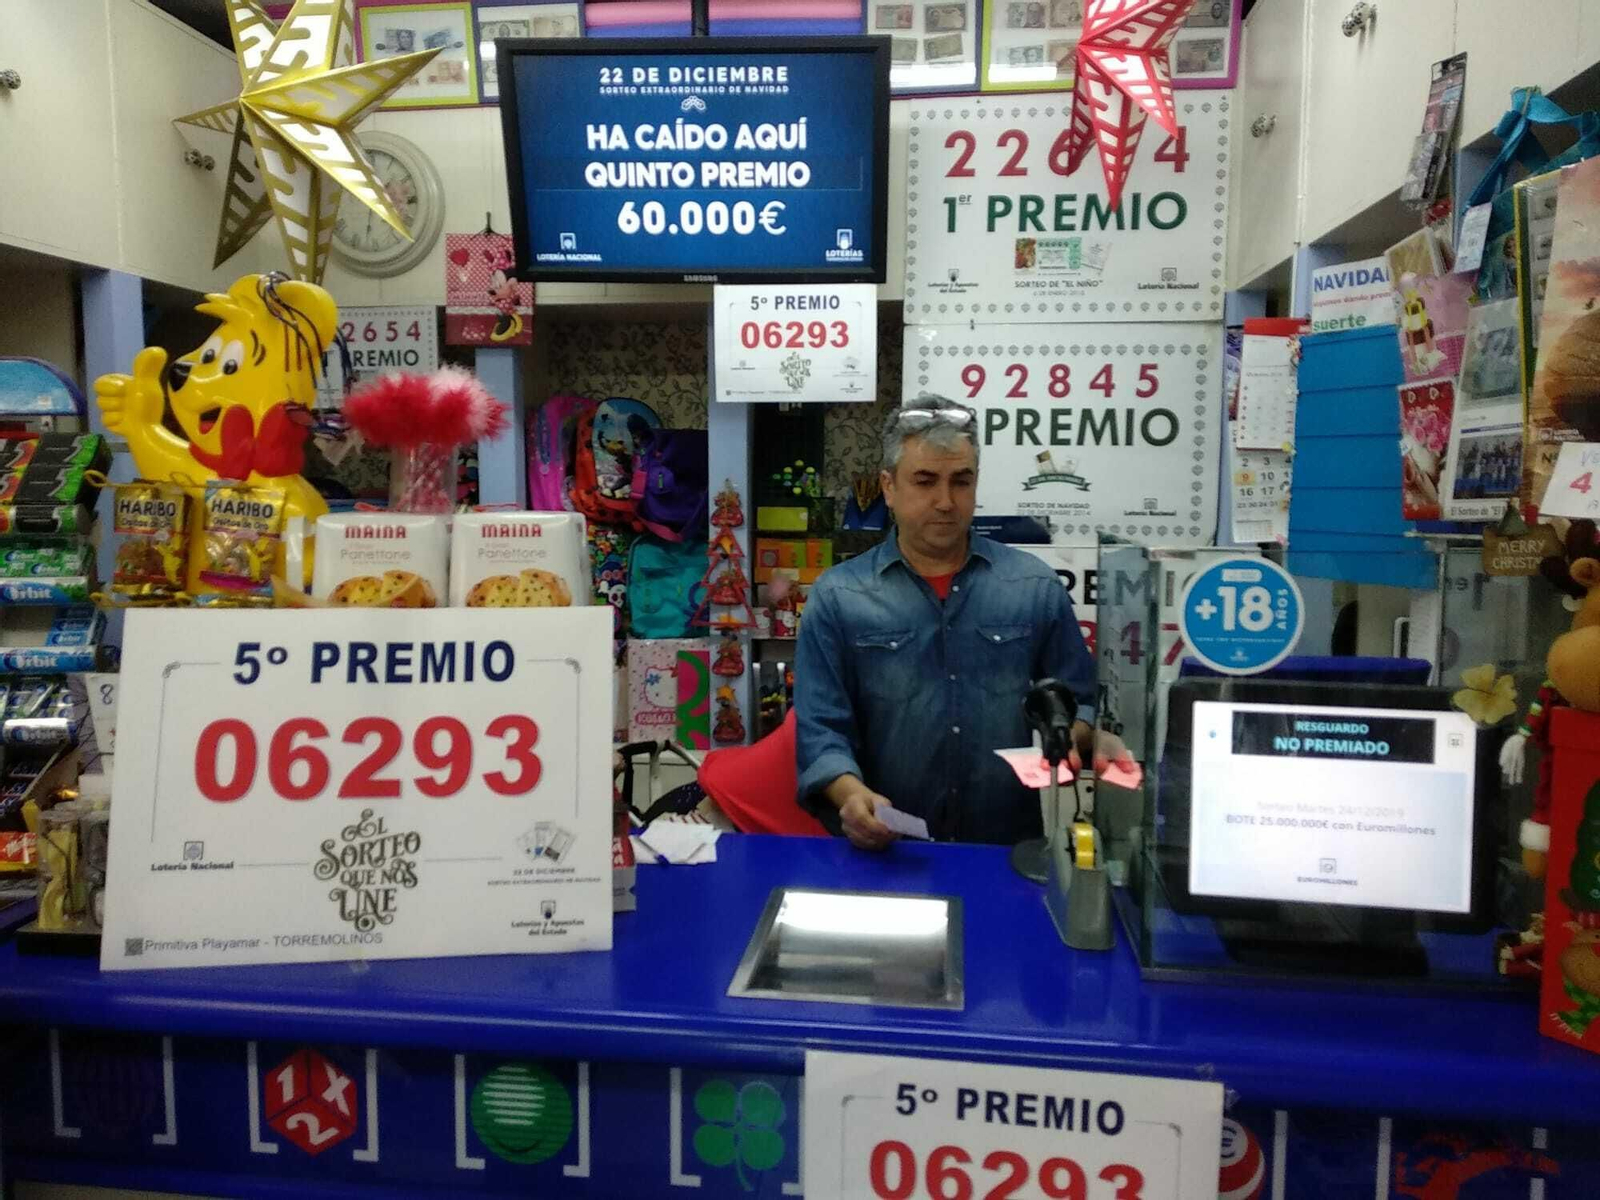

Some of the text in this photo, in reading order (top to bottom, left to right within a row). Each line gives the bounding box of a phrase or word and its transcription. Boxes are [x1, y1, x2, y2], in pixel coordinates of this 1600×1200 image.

[599, 66, 788, 83] 22 DE DICIEMBRE
[600, 86, 637, 94] SORTEO
[640, 86, 725, 94] EXTRAORDINARIO
[744, 85, 789, 93] NAVIDAD
[586, 117, 808, 150] HA CAÍDO AQUÍ
[584, 161, 811, 188] QUINTO PREMIO
[617, 200, 787, 236] 60.000€
[986, 191, 1188, 232] PREMIO
[774, 295, 840, 310] PREMIO
[1313, 314, 1366, 331] suerte
[741, 321, 849, 349] 06293
[961, 363, 1159, 398] 92845
[985, 408, 1180, 446] PREMIO
[1240, 487, 1254, 496] 16
[1569, 471, 1593, 494] 4
[119, 500, 176, 517] HARIBO
[211, 500, 274, 519] HARIBO
[340, 549, 412, 561] Panettone
[477, 548, 548, 560] Panettone
[1498, 540, 1546, 554] MERRY
[1195, 586, 1274, 632] +18
[1275, 588, 1288, 630] AÑOS
[311, 640, 516, 684] PREMIO
[1295, 720, 1370, 734] RESGUARDO
[1274, 736, 1391, 756] NO PREMIADO
[194, 714, 543, 803] 06293
[341, 808, 388, 842] EL
[1226, 815, 1437, 836] BOTE 25.000.000€ con Euromillones
[191, 862, 234, 871] Nacional
[314, 831, 421, 881] SORTEO
[340, 869, 376, 890] QUE
[145, 937, 198, 952] Primitiva
[202, 935, 260, 952] Playamar
[273, 932, 383, 947] TORREMOLINOS
[956, 1088, 1126, 1137] PREMIO
[869, 1140, 1146, 1200] 06293
